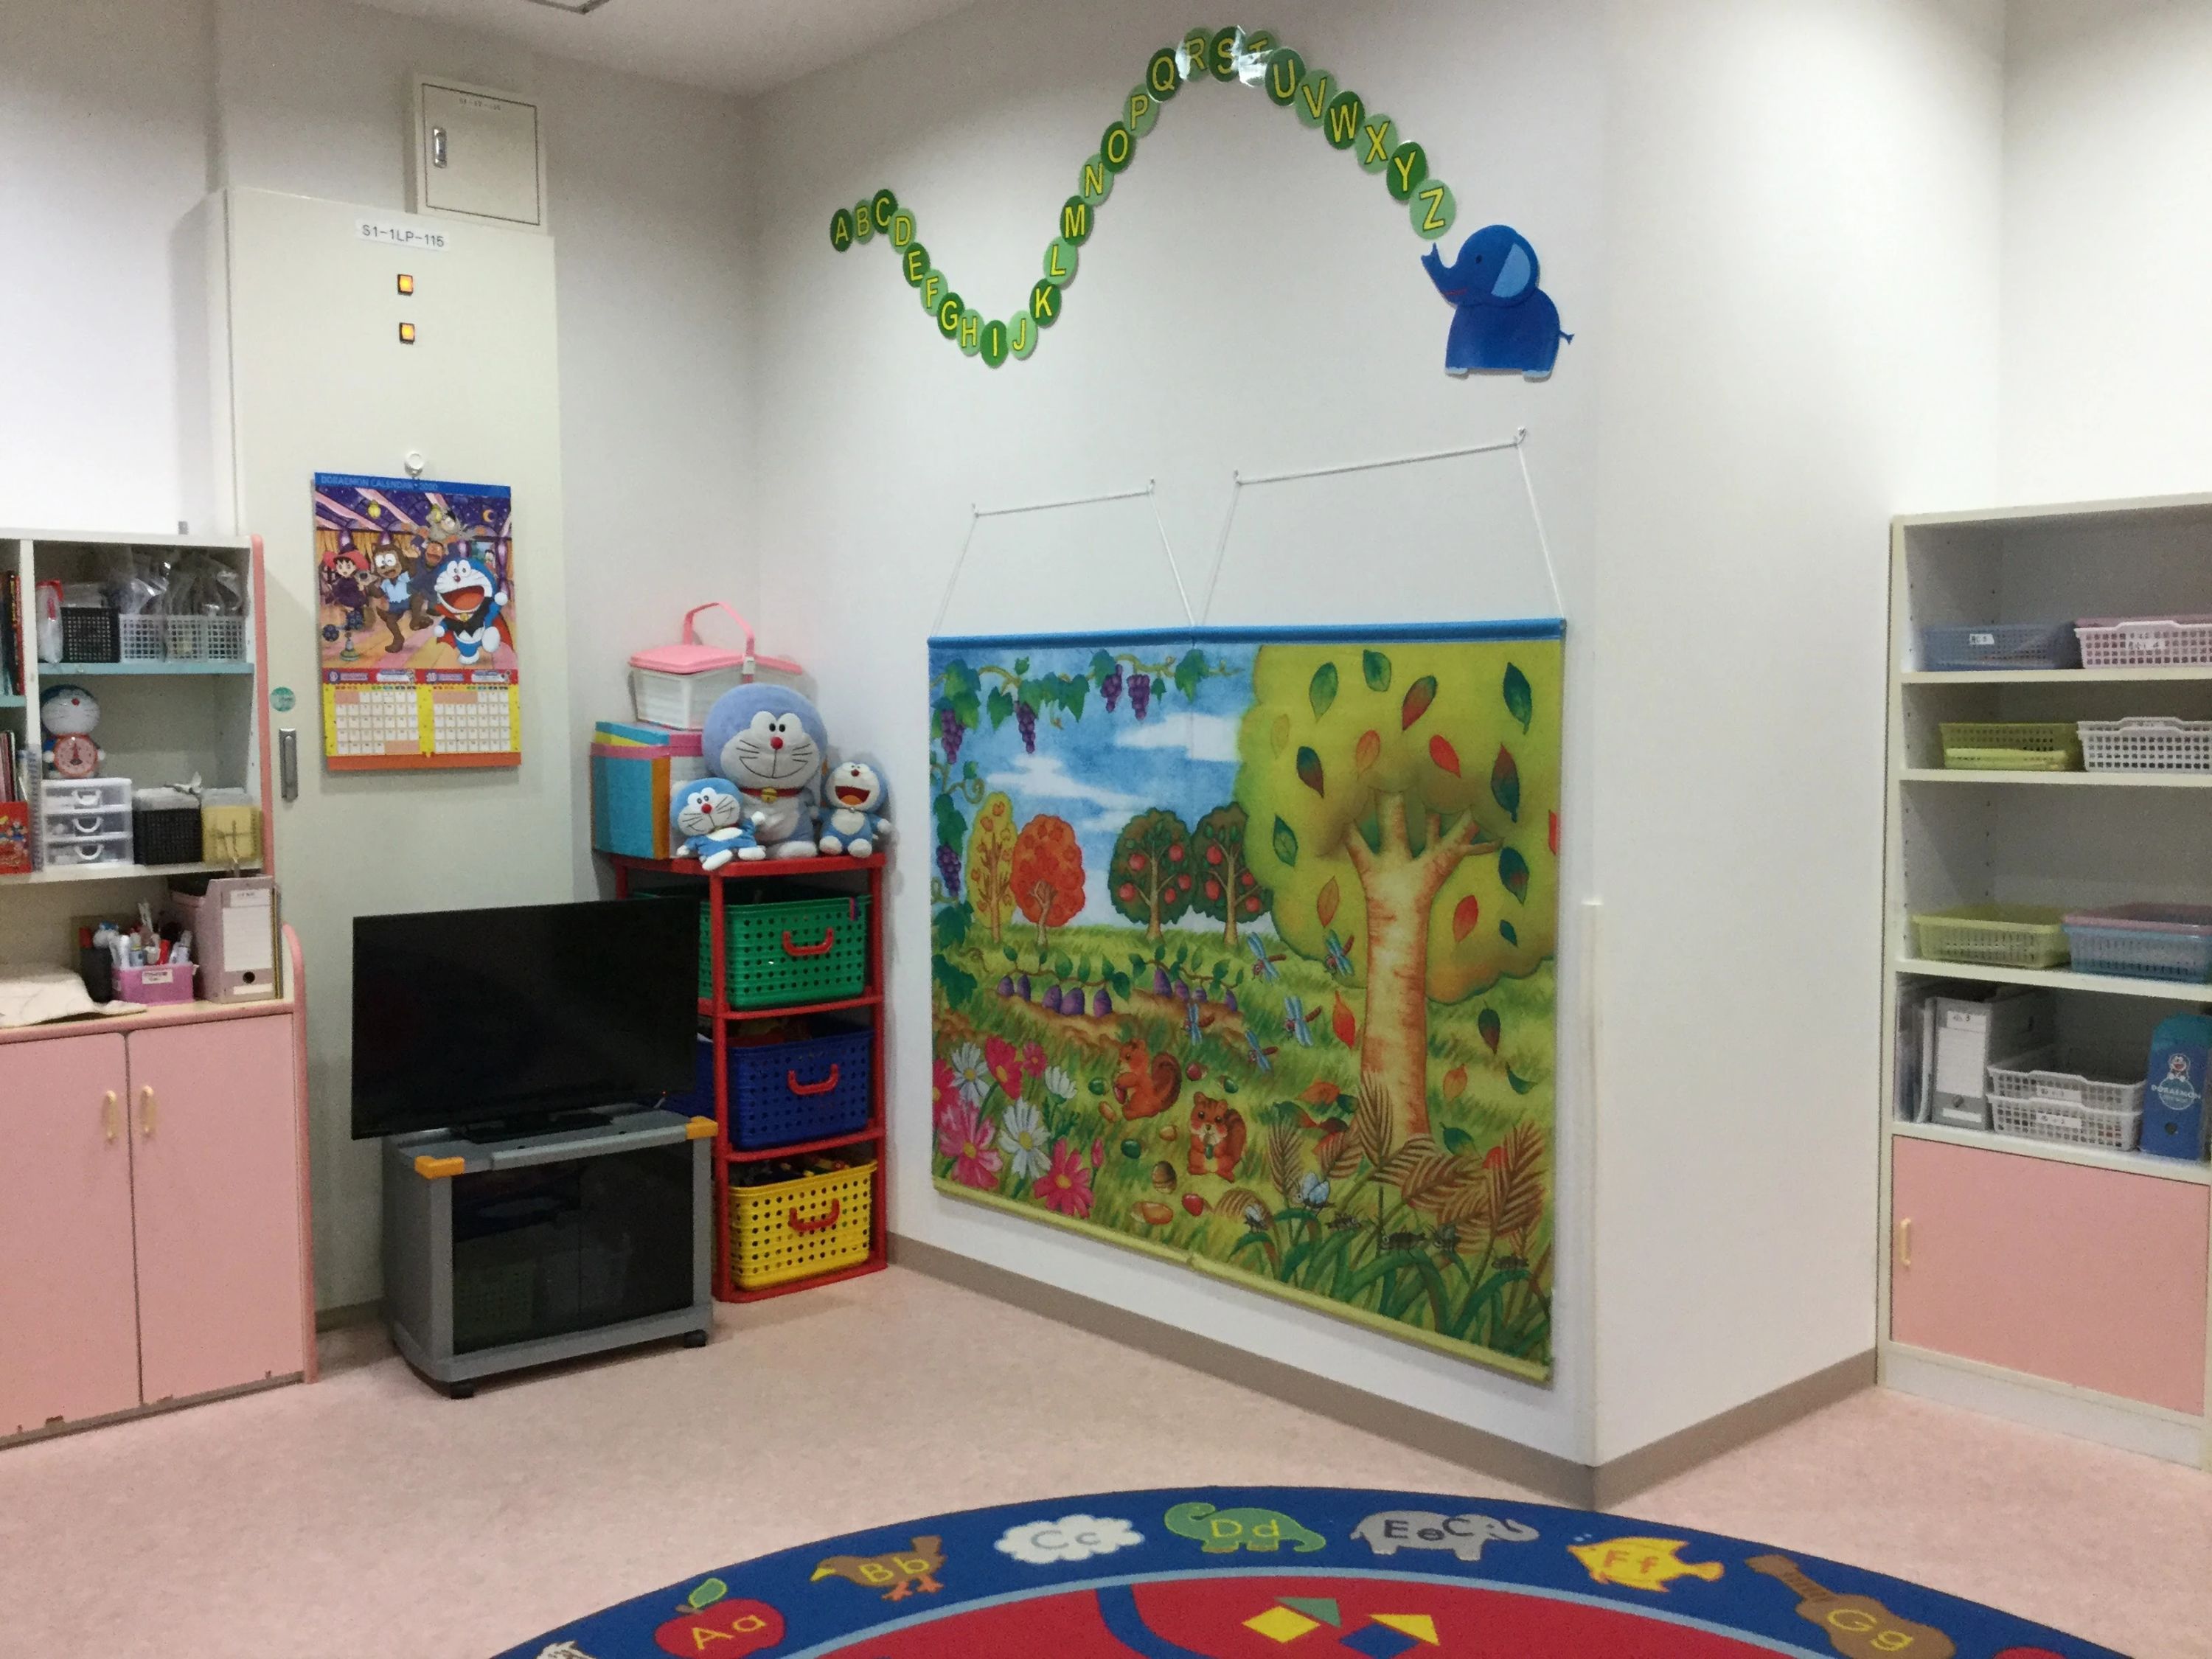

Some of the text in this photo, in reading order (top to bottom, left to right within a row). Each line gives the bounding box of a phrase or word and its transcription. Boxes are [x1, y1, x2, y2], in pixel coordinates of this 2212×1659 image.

[362, 223, 445, 248] S1-1LP-115
[835, 216, 849, 245] A
[855, 206, 872, 238] B
[875, 196, 891, 227] C
[894, 215, 912, 247] D
[907, 250, 924, 282] E
[925, 276, 940, 310] F
[940, 299, 959, 332] G
[961, 316, 978, 349] H
[1012, 318, 1027, 352] J
[1034, 285, 1053, 319] K
[1049, 244, 1067, 277] L
[1064, 203, 1086, 239] M
[1084, 161, 1105, 198] N
[1107, 128, 1129, 164] O
[1130, 94, 1150, 132] P
[1152, 55, 1175, 92] Q
[1184, 38, 1208, 72] R
[1217, 37, 1239, 74] S
[1273, 58, 1296, 99] U
[1301, 76, 1327, 119] V
[1329, 100, 1359, 144] W
[1363, 119, 1391, 165] X
[1394, 150, 1416, 193] Y
[1418, 186, 1446, 232] Z
